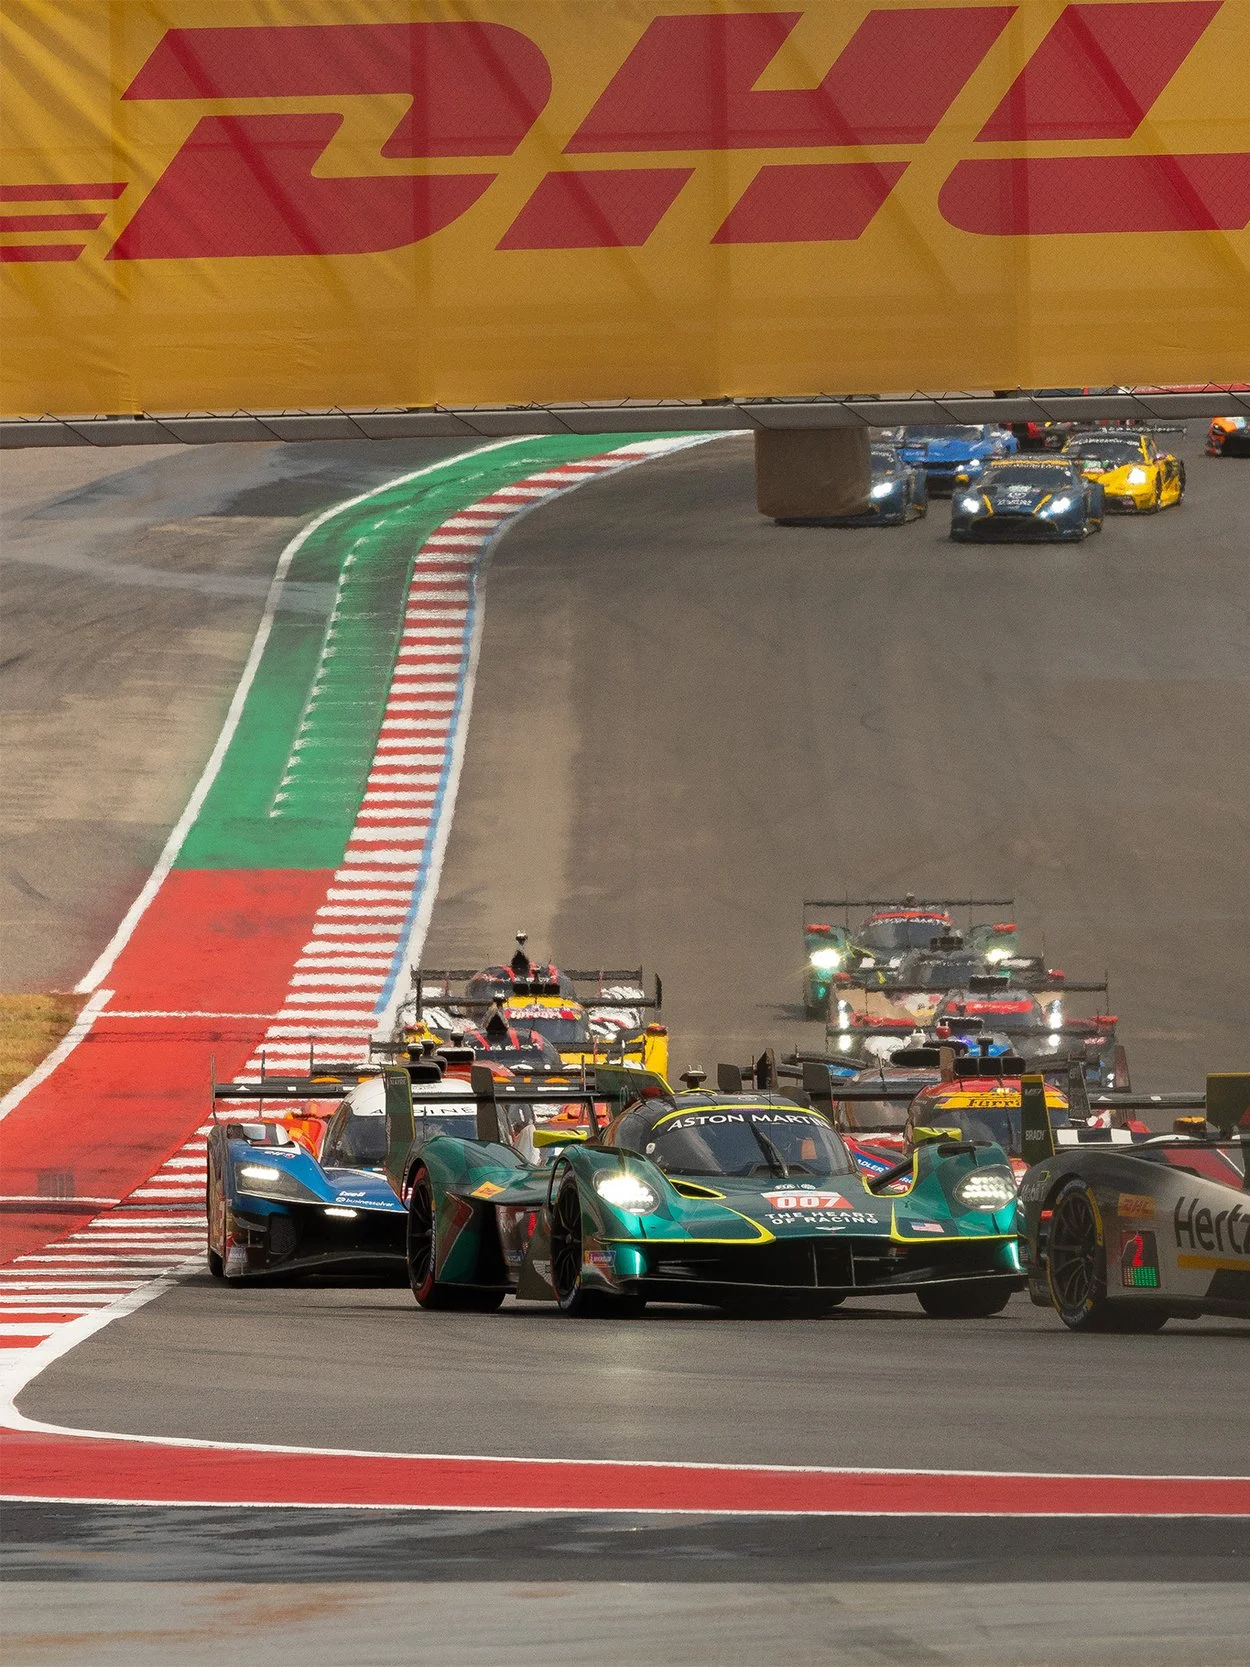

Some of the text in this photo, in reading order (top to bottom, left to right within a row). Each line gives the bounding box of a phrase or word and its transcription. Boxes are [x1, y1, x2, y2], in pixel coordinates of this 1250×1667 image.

[667, 1114, 832, 1132] ASTON MARTIN
[776, 1196, 841, 1209] 007
[811, 1211, 876, 1219] HEART
[772, 1217, 796, 1225] OF
